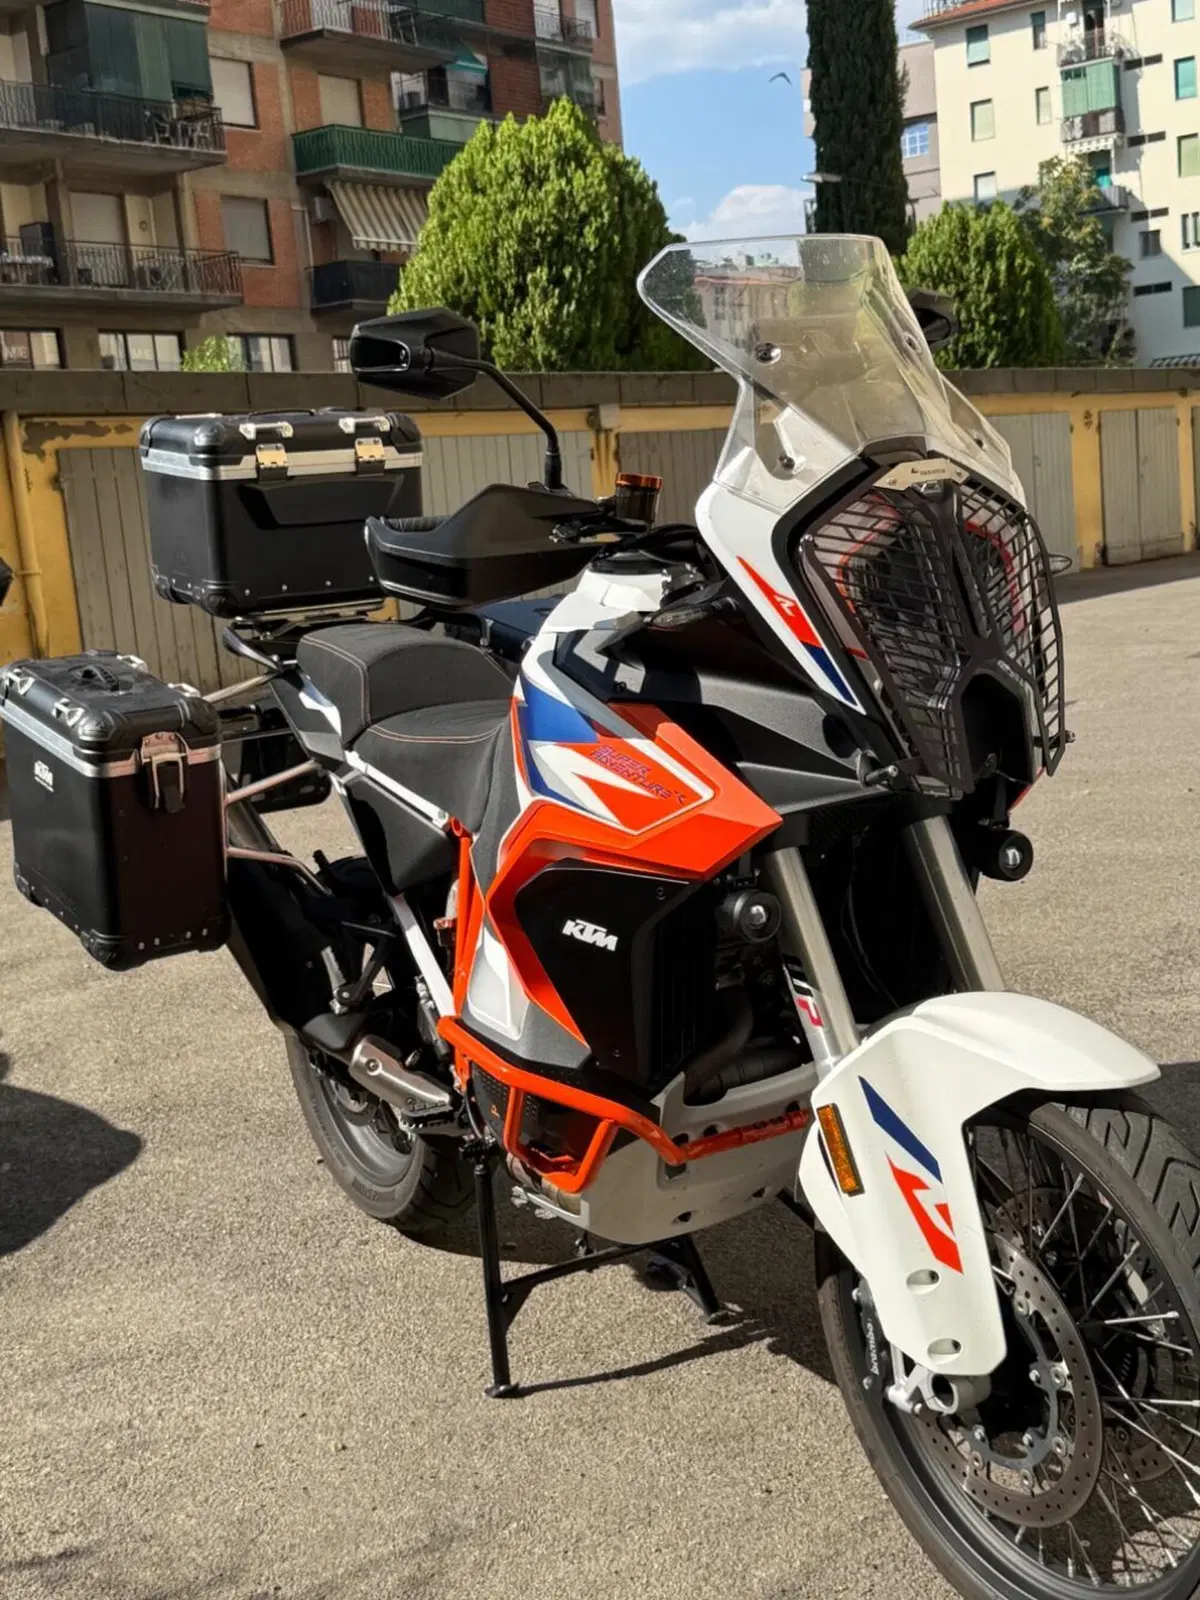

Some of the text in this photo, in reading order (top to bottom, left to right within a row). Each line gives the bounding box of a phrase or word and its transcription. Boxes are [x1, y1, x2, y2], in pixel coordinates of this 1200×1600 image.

[34, 760, 53, 786] KTM
[589, 750, 672, 800] ADVENTURE
[599, 744, 651, 775] SUPER
[562, 918, 618, 951] KTM
[867, 1322, 880, 1375] brembo
